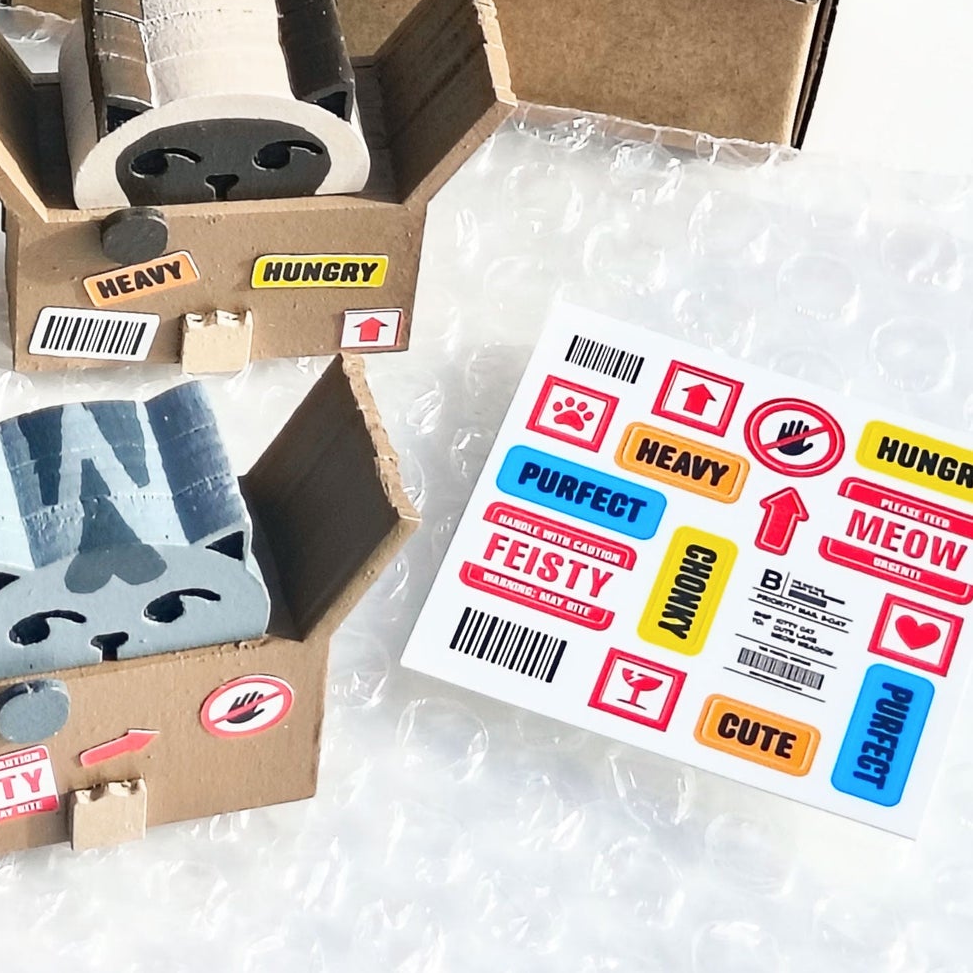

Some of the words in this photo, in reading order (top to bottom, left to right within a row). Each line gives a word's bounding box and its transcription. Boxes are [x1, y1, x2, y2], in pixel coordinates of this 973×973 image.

[96, 260, 182, 300] HEAVY
[262, 261, 378, 283] HUNGRY
[635, 438, 730, 487] HEAVY
[876, 436, 973, 489] HUNGR
[517, 461, 647, 523] PURFECT
[880, 498, 921, 519] PLEASE
[923, 512, 951, 528] FEED
[497, 514, 540, 536] HANDLE
[542, 527, 572, 547] WITH
[572, 540, 622, 564] CAUTION
[845, 508, 968, 572] MEOW
[483, 532, 614, 598] FEISTY
[760, 568, 783, 590] B
[482, 571, 537, 598] WARNING:
[538, 591, 565, 607] MAY
[565, 600, 591, 617] BITE
[657, 542, 718, 640] CHONKY
[717, 711, 798, 760] CUTE
[852, 681, 914, 791] PURFECT
[17, 801, 43, 814] BITE
